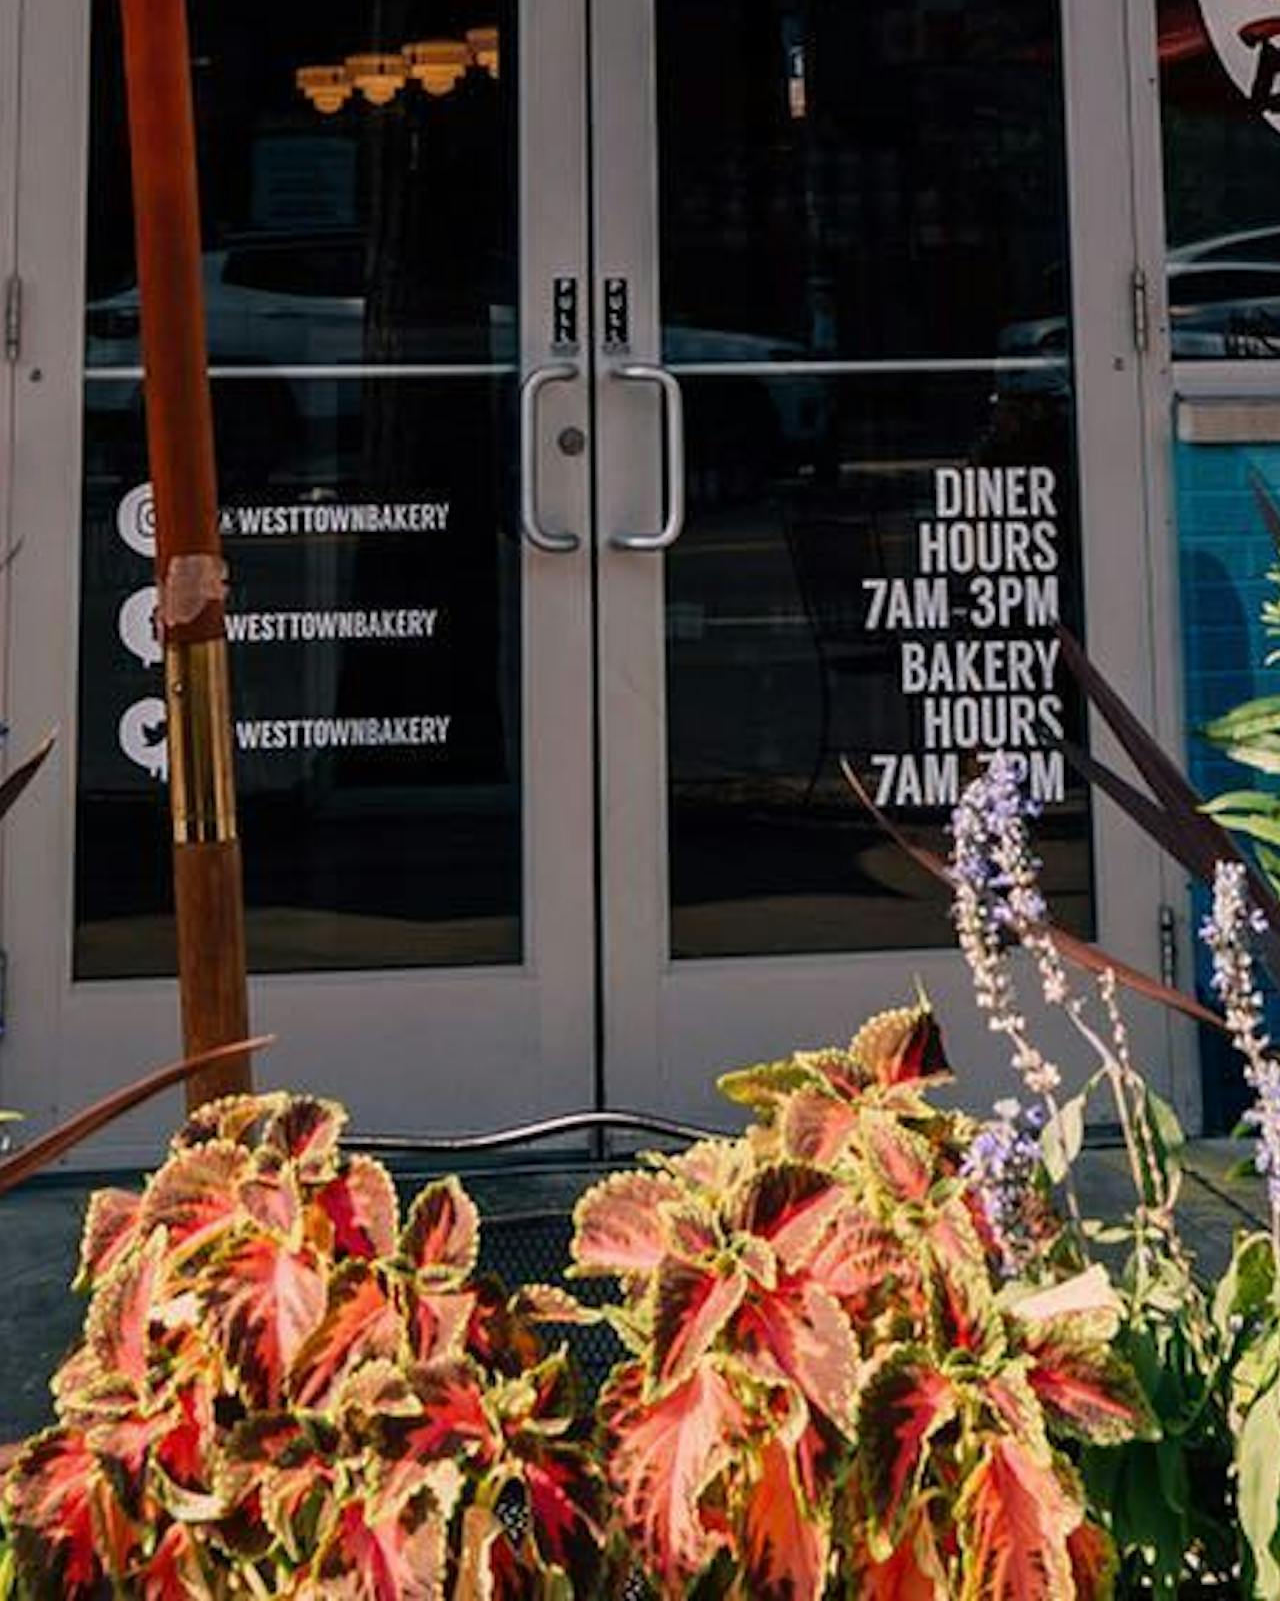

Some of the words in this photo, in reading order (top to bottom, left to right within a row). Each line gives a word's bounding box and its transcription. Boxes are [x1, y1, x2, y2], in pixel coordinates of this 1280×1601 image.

[935, 466, 1057, 518] DINER
[920, 521, 1058, 573] HOURS
[223, 609, 438, 642] WESTTOWNBAKERY
[901, 639, 1061, 694] BAKERY
[235, 715, 451, 749] WESTTOWNBAKERY
[924, 694, 1064, 749] HOURS
